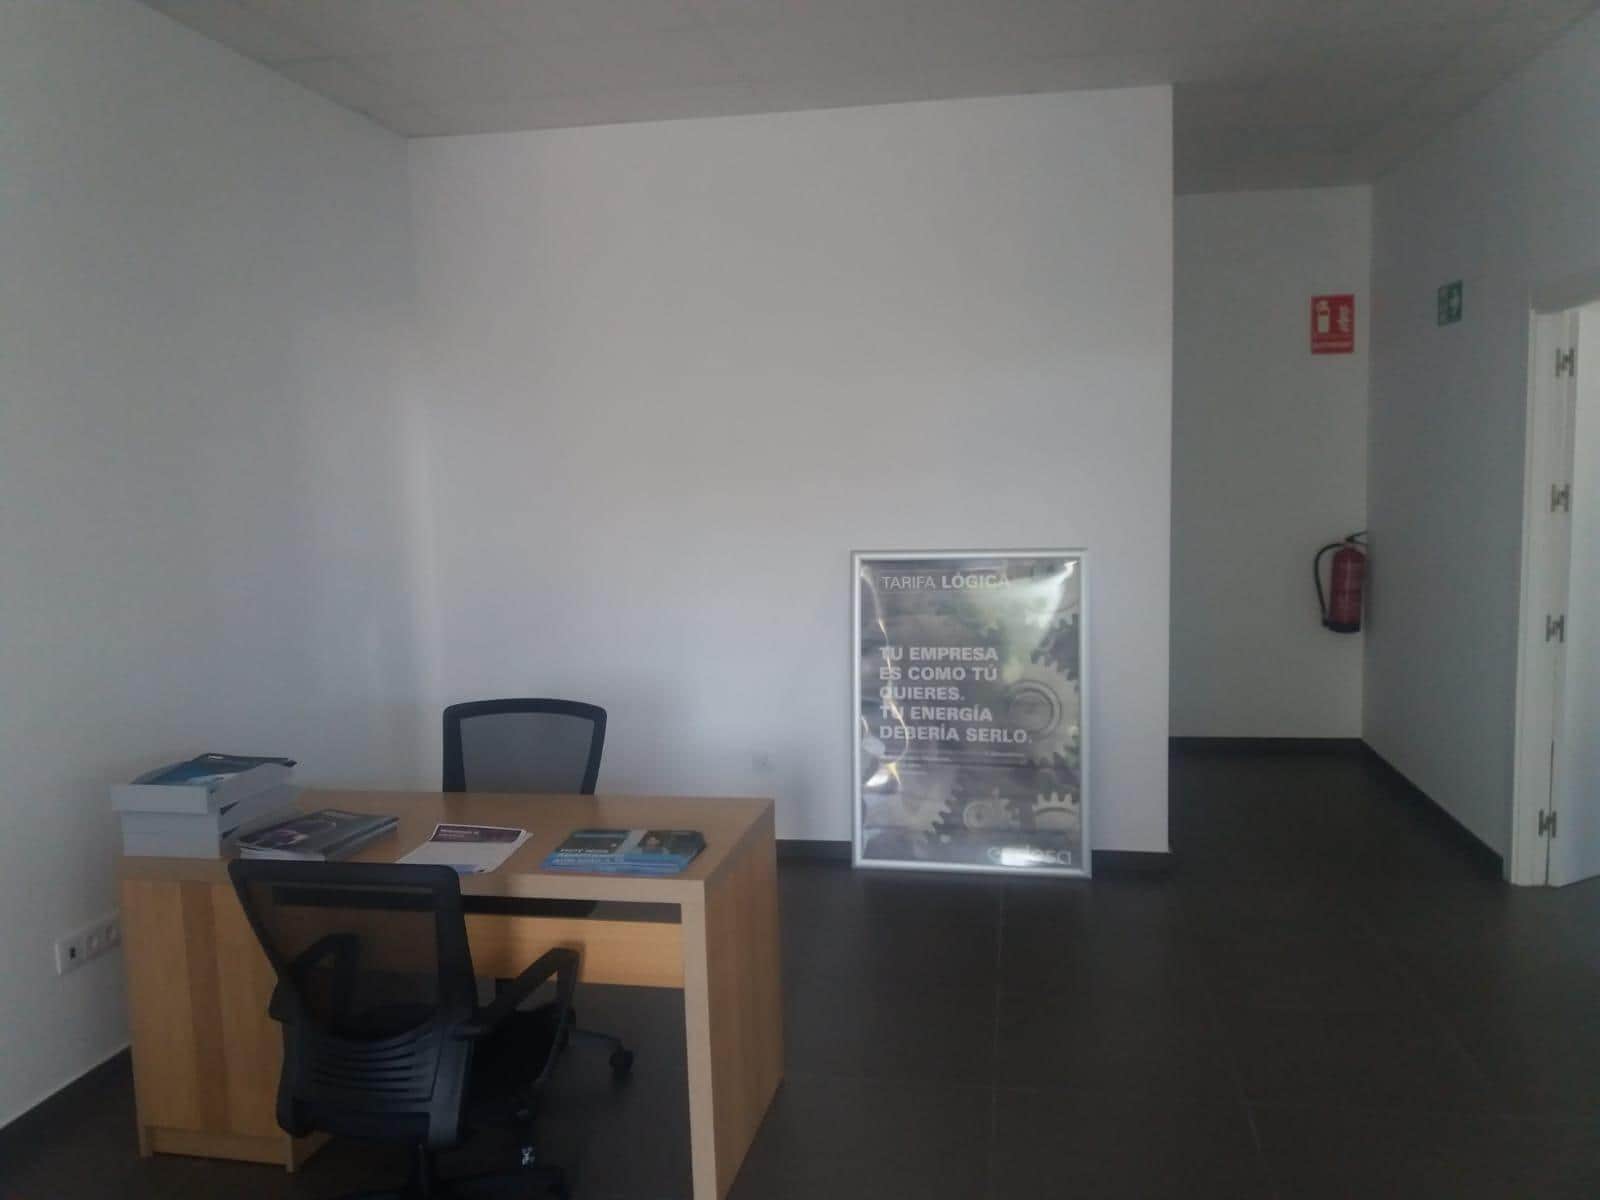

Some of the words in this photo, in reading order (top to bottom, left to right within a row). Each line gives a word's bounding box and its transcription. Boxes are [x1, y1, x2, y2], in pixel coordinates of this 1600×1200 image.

[881, 576, 935, 589] TARIFA
[942, 573, 1009, 589] LÓGICA
[880, 647, 903, 660] TU
[909, 647, 998, 661] EMPRESA
[880, 666, 902, 680] ES
[908, 666, 966, 681] COMO
[971, 664, 997, 681] TÚ
[880, 686, 965, 701] QUIERES.
[910, 704, 992, 721] ENERGÍA
[880, 723, 960, 741] DEBERÍA
[966, 728, 1032, 744] SERLO.
